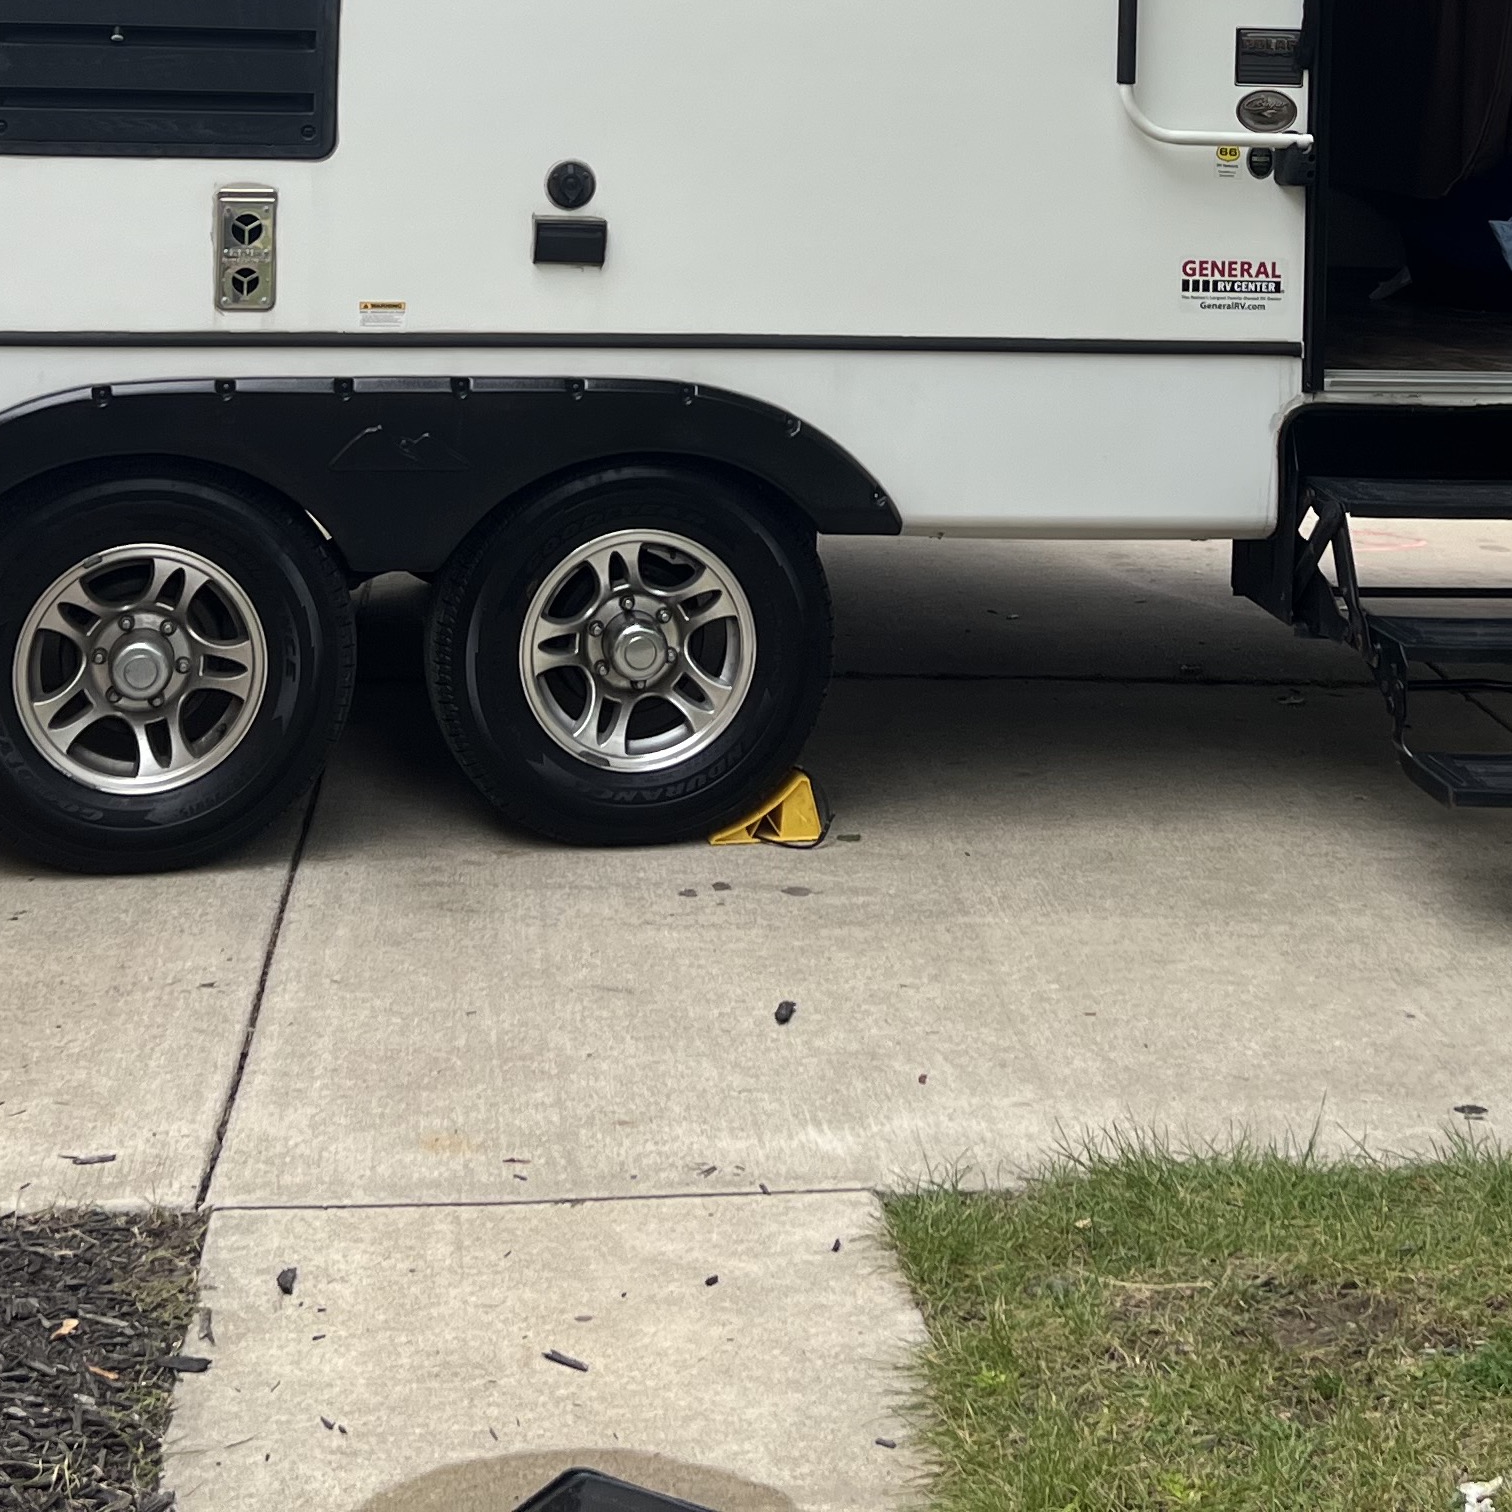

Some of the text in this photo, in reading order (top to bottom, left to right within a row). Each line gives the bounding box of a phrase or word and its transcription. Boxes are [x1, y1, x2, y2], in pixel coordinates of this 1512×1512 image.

[1182, 260, 1282, 279] GENERAL
[1217, 281, 1276, 293] RV CENTER
[1199, 301, 1266, 311] GeneralRV.com
